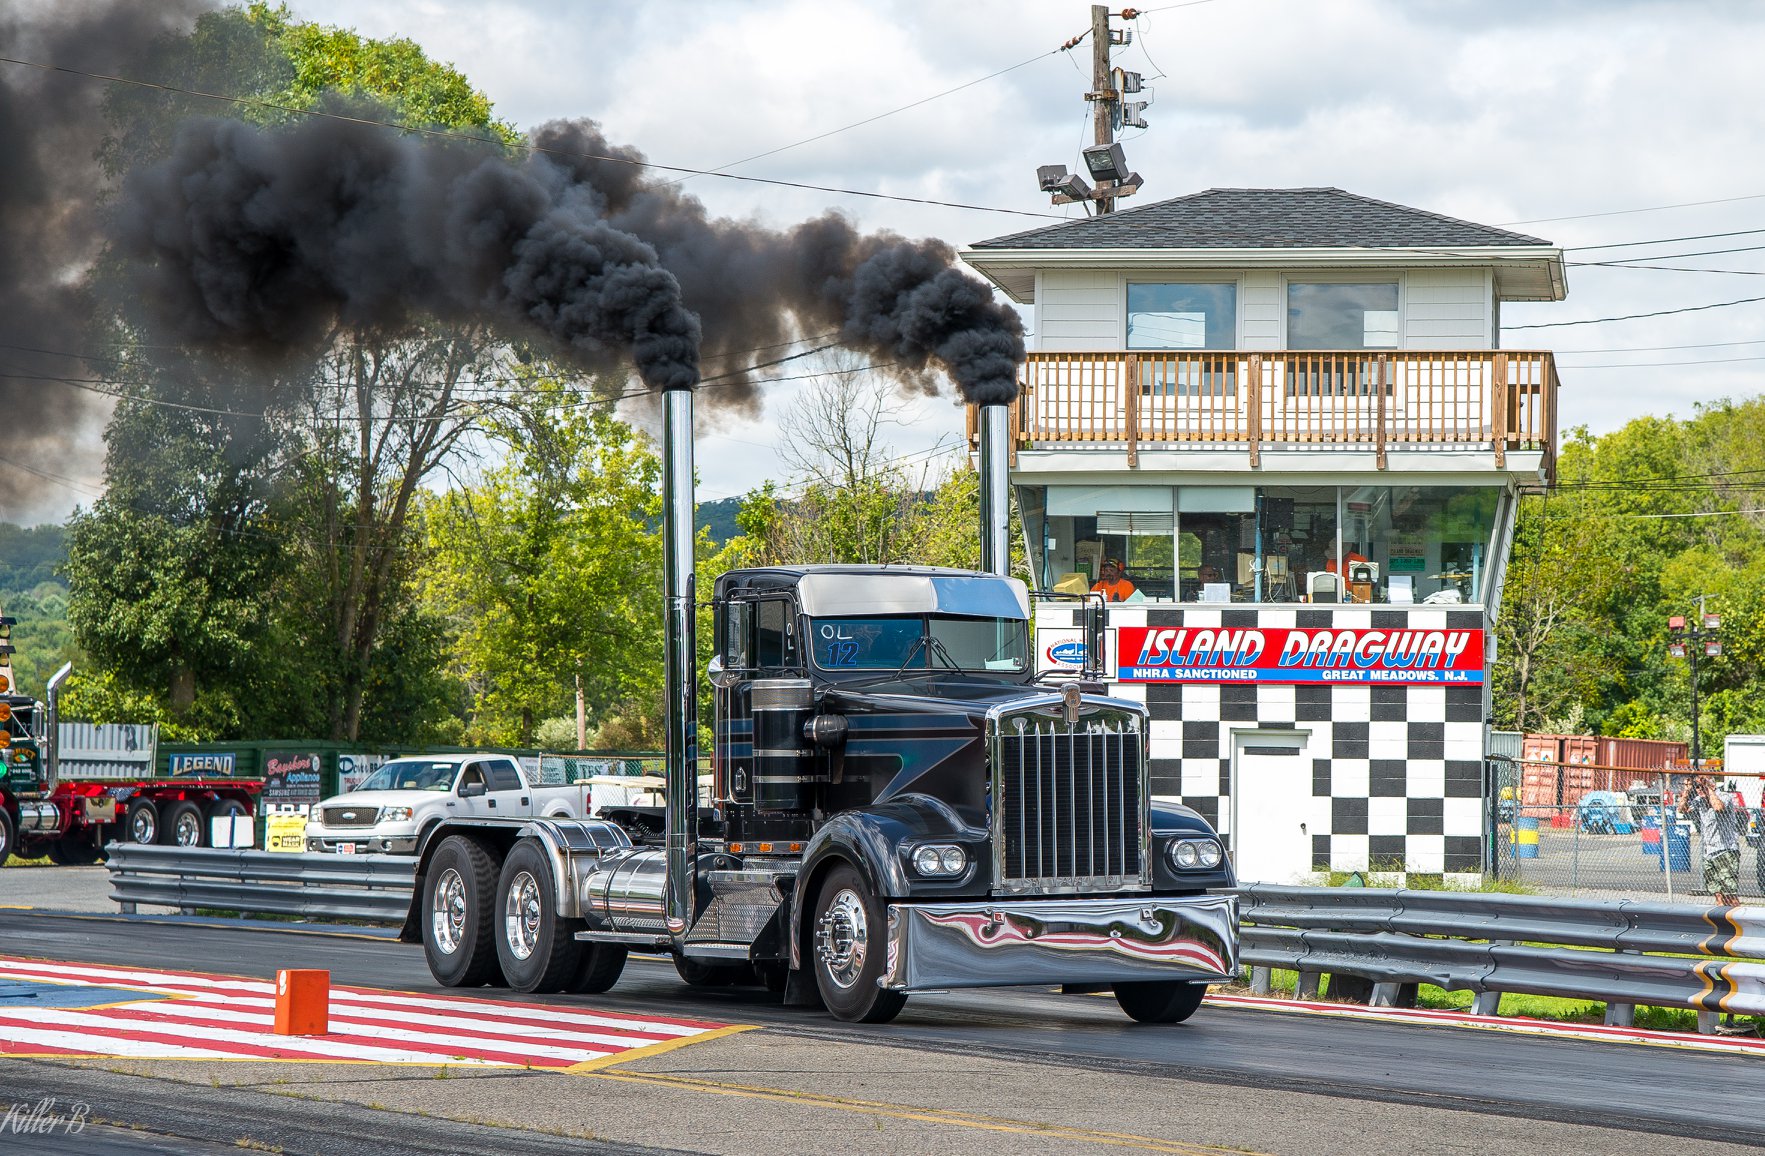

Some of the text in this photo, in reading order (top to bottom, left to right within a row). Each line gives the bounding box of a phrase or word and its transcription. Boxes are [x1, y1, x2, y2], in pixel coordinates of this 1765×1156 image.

[820, 624, 853, 640] OL
[1050, 638, 1077, 648] NATIONAL
[1136, 629, 1471, 668] ISLAND DRAGWAY
[827, 641, 860, 667] 12
[1057, 661, 1084, 670] ASSOCIA
[1132, 668, 1258, 679] NHRA SANCTIONED
[1321, 670, 1368, 680] GREAT
[1443, 670, 1469, 681] N.J.
[173, 756, 233, 775] LEGEND
[267, 755, 311, 777] Bayshore
[286, 771, 320, 784] Appliance
